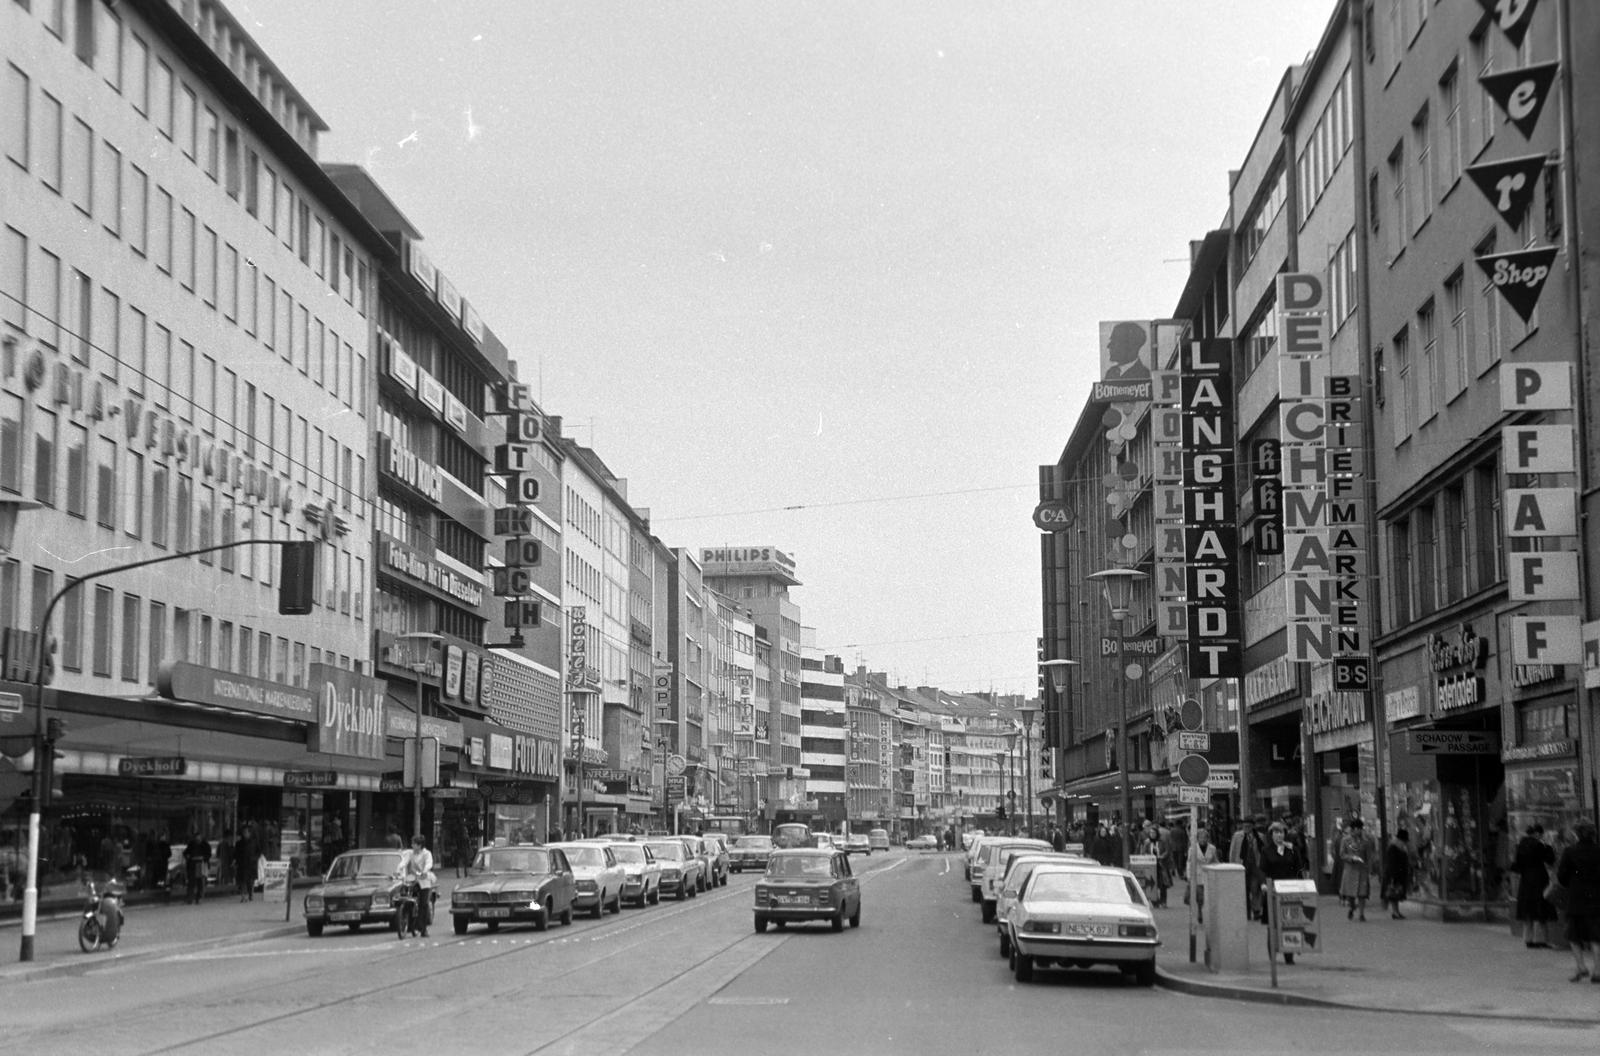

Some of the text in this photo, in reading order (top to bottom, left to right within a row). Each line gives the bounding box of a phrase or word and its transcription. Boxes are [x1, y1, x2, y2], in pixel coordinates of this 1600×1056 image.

[1494, 258, 1549, 288] Shop
[1094, 382, 1151, 400] Bornemeyer
[387, 439, 416, 487] FOTO
[511, 385, 540, 500] FOTO
[1284, 273, 1332, 660] DEICHMANN
[1040, 508, 1069, 523] C&A
[1160, 374, 1187, 631] POHLAND
[1190, 341, 1228, 675] LANGHARDT
[1330, 377, 1360, 652] BRIEFMARKEN
[1513, 367, 1548, 660] PFAFF
[510, 509, 540, 626] KOCH
[703, 548, 770, 562] PHILIPS
[1102, 637, 1159, 656] Bonemeyer
[325, 680, 385, 741] Dyckhoff
[657, 676, 669, 748] OPTK
[515, 733, 559, 778] FOTO KOCH
[1415, 733, 1464, 744] SCHADOW
[122, 758, 182, 773] Dyckhoff
[286, 773, 333, 786] Dyckhoff
